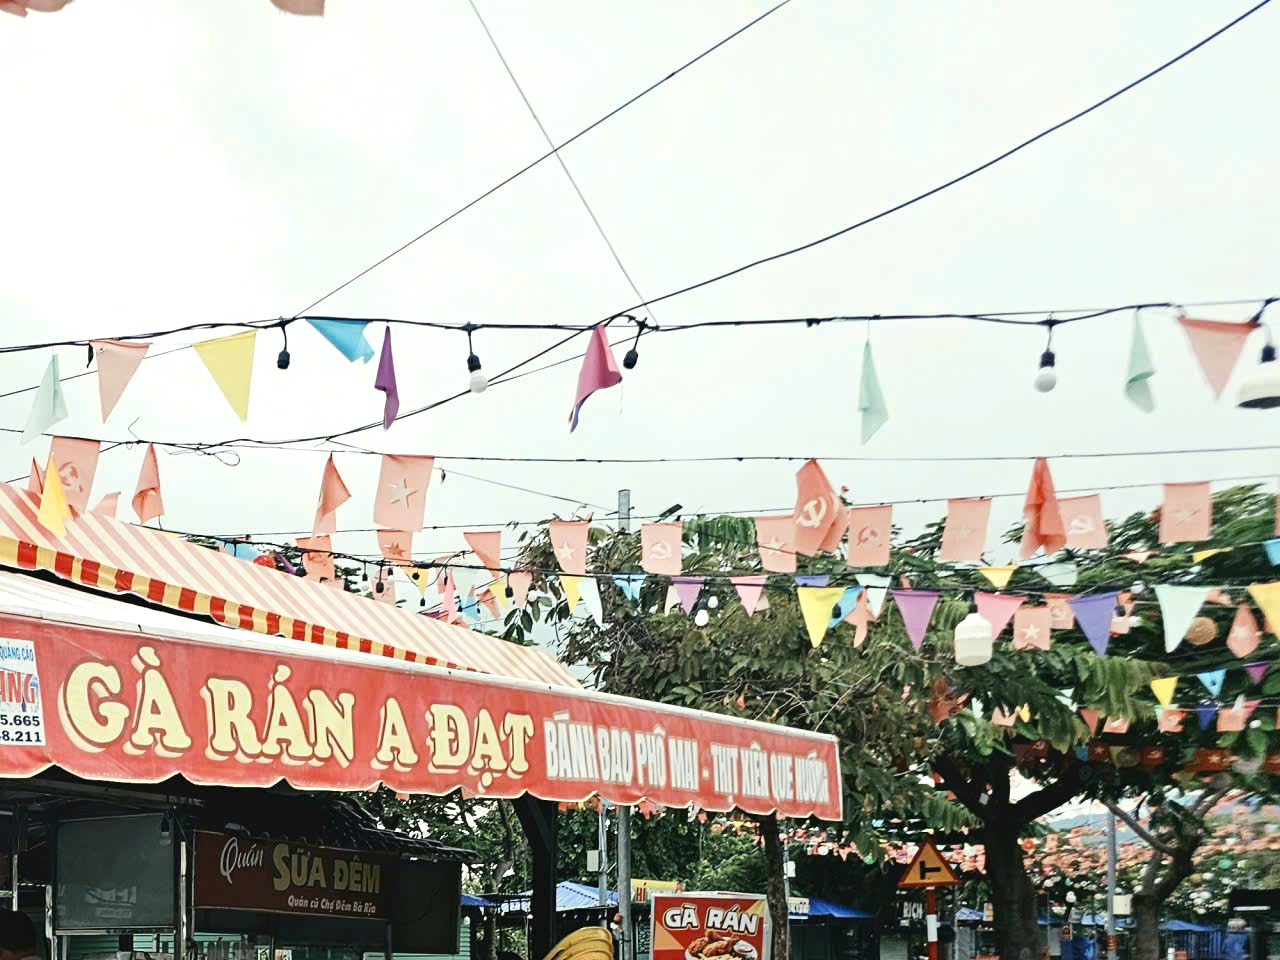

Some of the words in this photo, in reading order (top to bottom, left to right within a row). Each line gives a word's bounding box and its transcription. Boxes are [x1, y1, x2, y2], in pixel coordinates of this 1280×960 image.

[59, 646, 192, 756] GÀ
[204, 664, 355, 770] RÁN
[371, 697, 419, 772] A
[425, 702, 535, 792] ĐẠT
[544, 710, 600, 780] BÁNH
[597, 725, 634, 785] BAO
[634, 724, 667, 789] PHÔ
[668, 736, 699, 792] MAI
[220, 837, 264, 884] Quán
[273, 843, 327, 892] SỮA
[333, 855, 382, 894] ĐÊM
[663, 903, 699, 929] GÀ
[706, 905, 759, 936] RÁN
